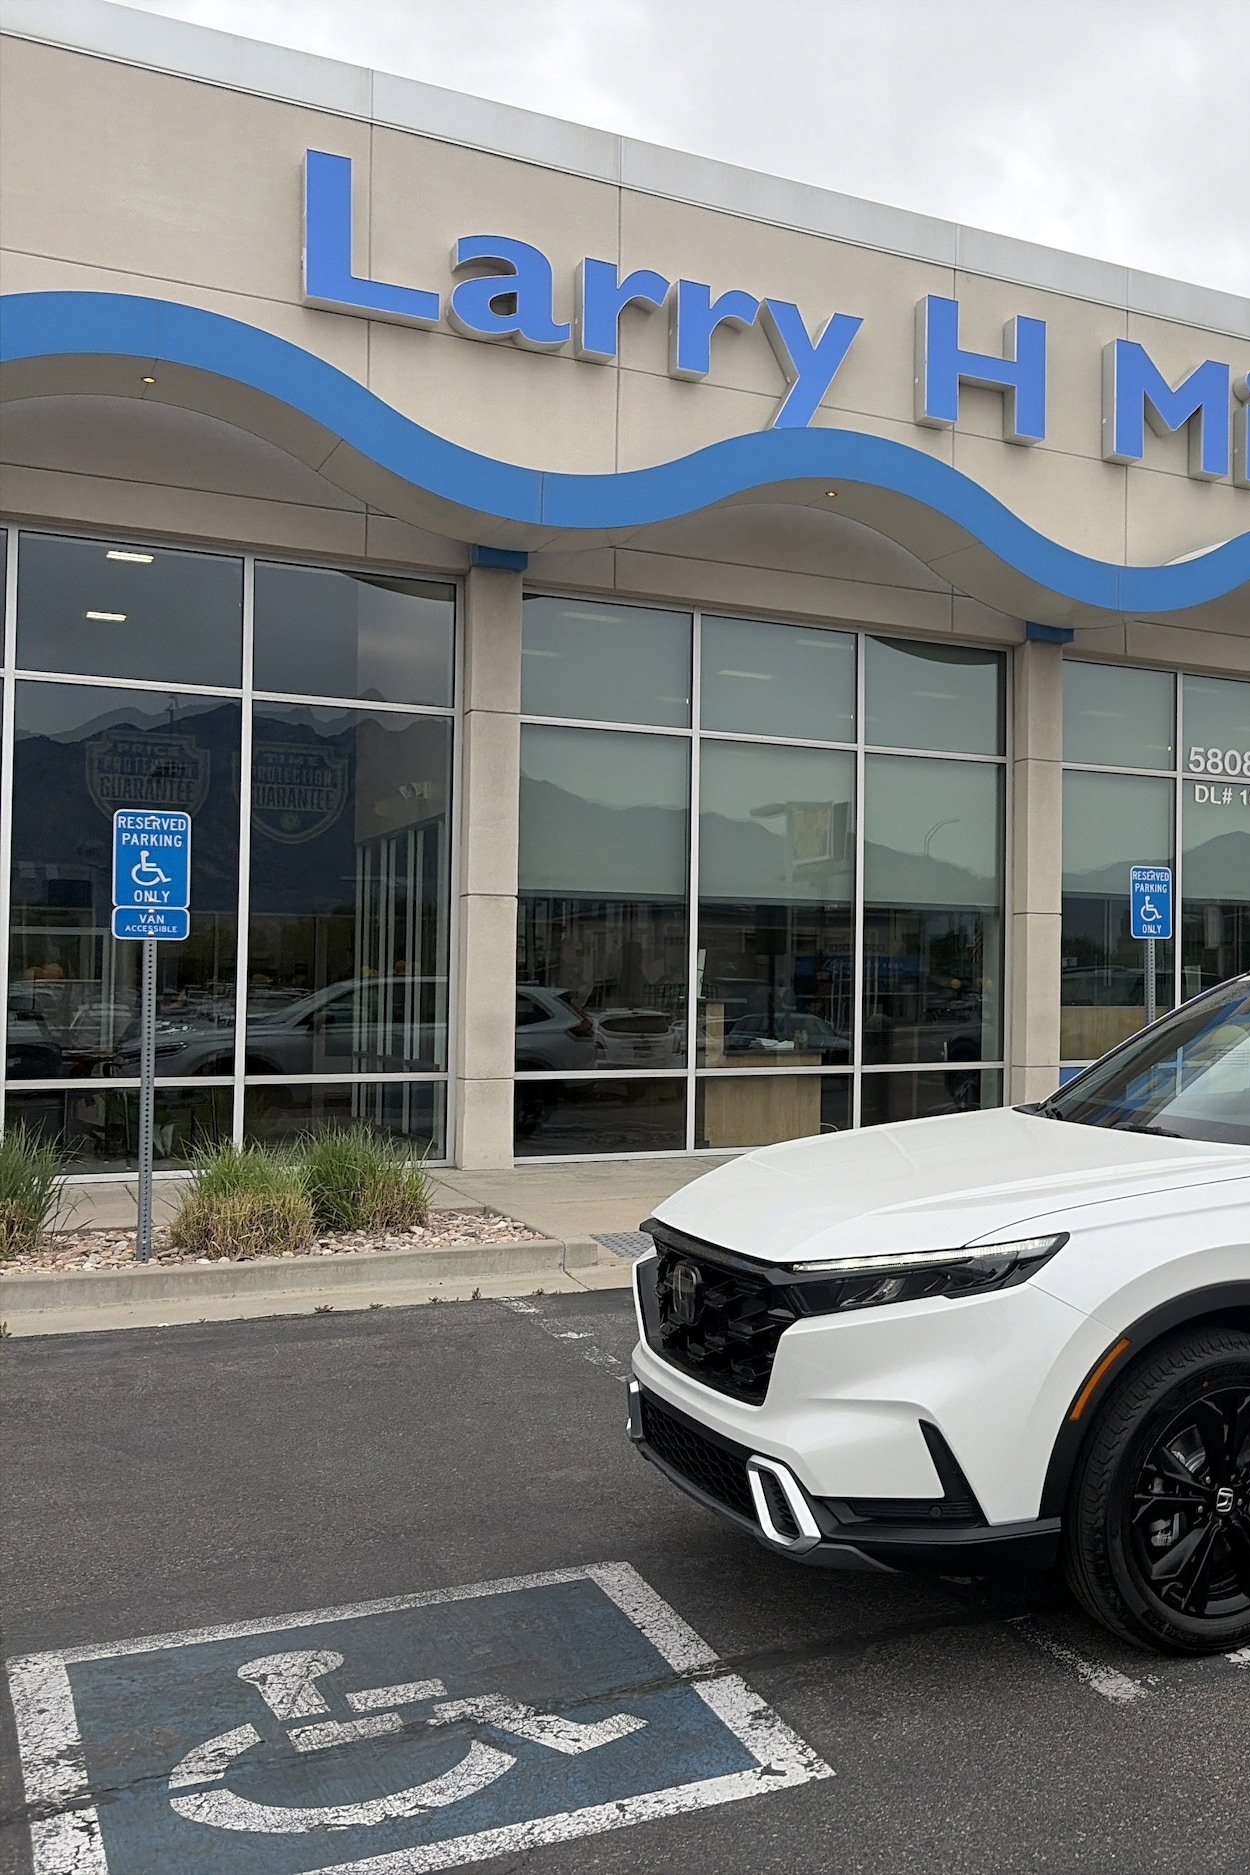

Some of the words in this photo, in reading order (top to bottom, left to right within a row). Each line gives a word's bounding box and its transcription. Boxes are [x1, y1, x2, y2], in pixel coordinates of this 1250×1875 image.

[303, 148, 864, 428] Larry
[915, 294, 1047, 444] H
[252, 785, 335, 811] UARANTEE
[1194, 784, 1233, 805] DL#
[118, 816, 187, 831] RESERVED
[122, 833, 182, 847] PARKING
[1132, 870, 1169, 882] RESERVED
[1135, 883, 1168, 894] PARKING
[134, 890, 170, 903] ONLY
[139, 914, 165, 925] VAN
[125, 925, 178, 933] ACCESSIBLE
[1142, 924, 1162, 934] ONLY
